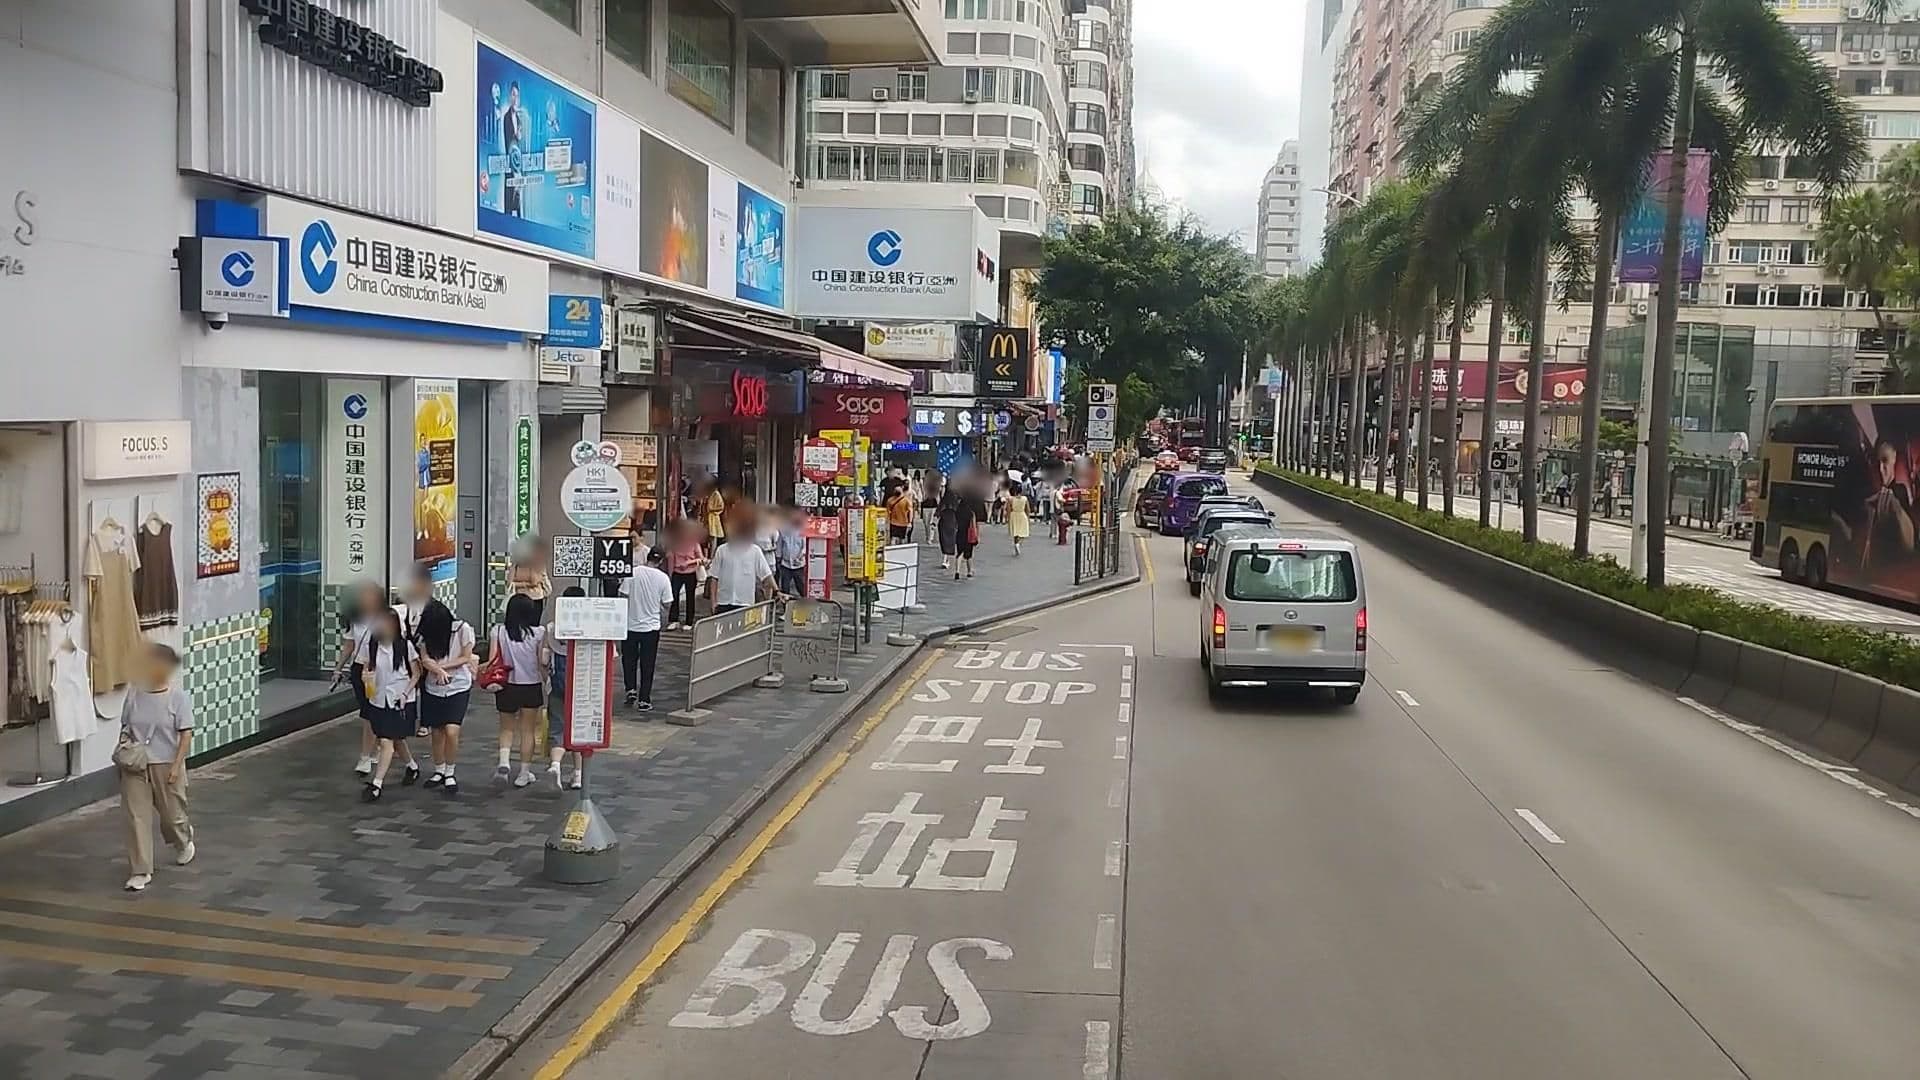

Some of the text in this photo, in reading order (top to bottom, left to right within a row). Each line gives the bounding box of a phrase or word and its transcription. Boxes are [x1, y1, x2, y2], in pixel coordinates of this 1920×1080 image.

[346, 237, 507, 295] 中国建设银行(亞洲)
[812, 269, 958, 287] 中国建设银行(亞洲)
[346, 272, 378, 294] China
[381, 278, 439, 304] Construction
[823, 283, 847, 292] China
[849, 284, 899, 293] Construction
[565, 299, 591, 321] 24
[345, 423, 367, 573] 中国建设银行(亞洲)
[600, 560, 632, 574] 559a
[953, 649, 1087, 672] BUS
[911, 678, 1098, 705] STOP
[870, 714, 1065, 776] 巴士
[813, 791, 1028, 892] 站
[668, 927, 1015, 1042] BUS
